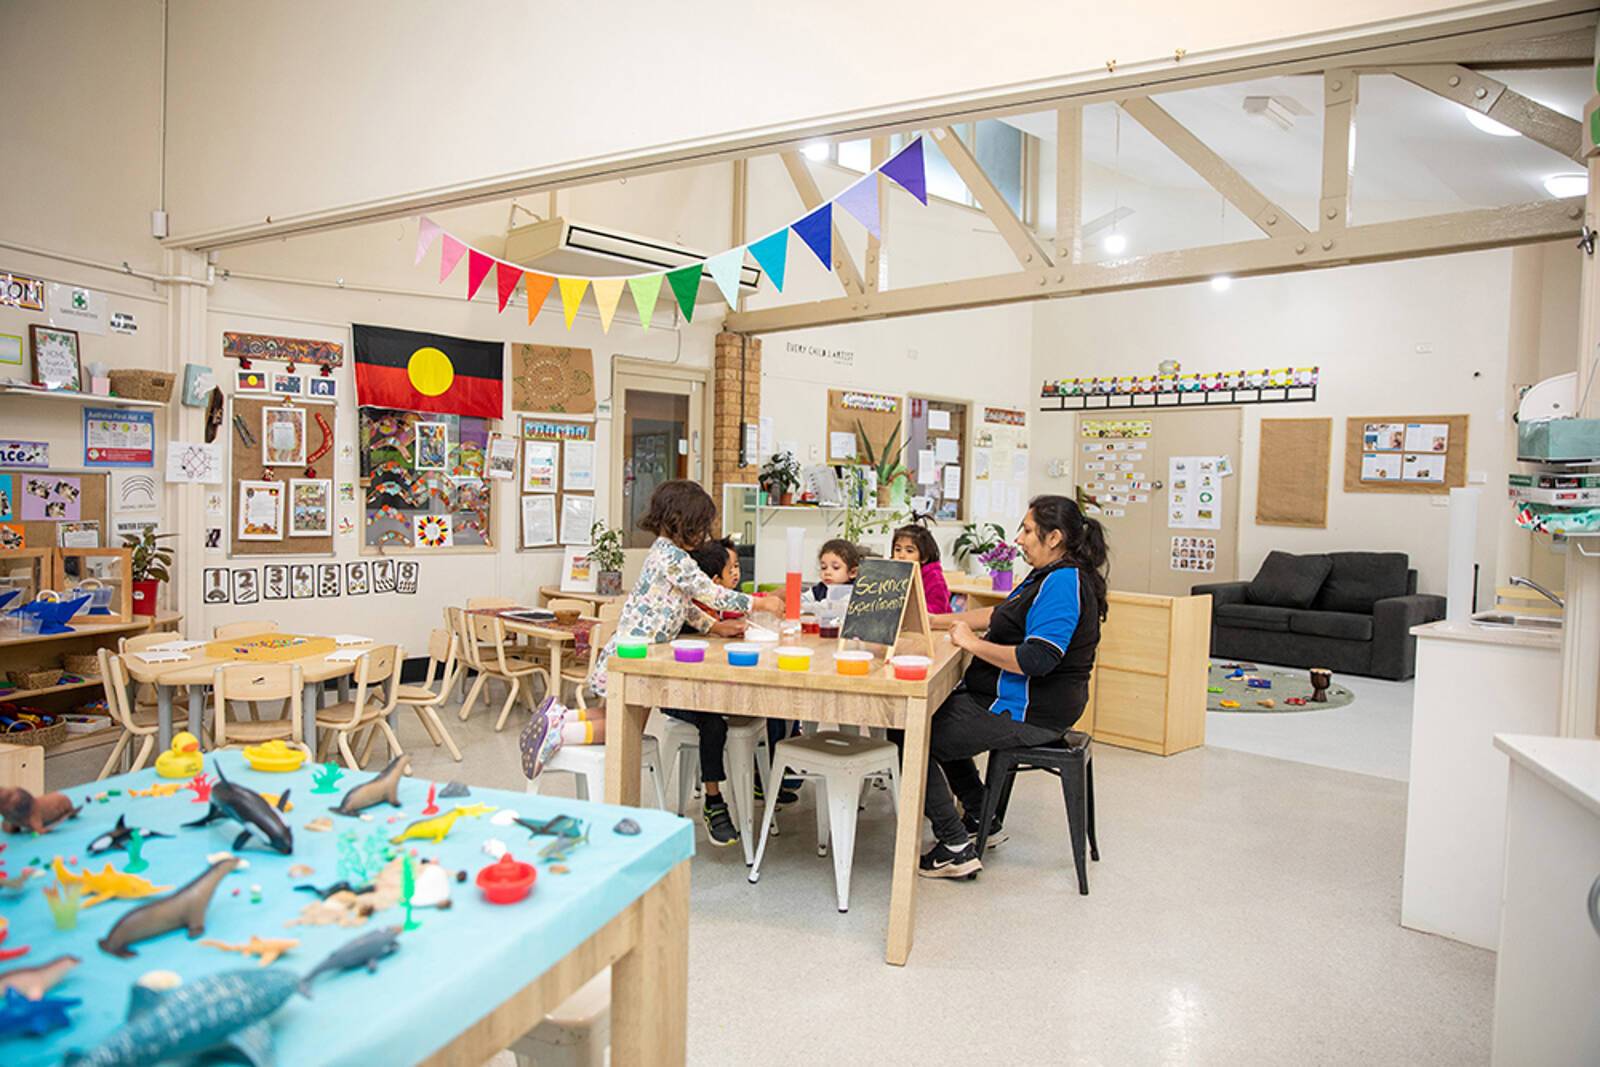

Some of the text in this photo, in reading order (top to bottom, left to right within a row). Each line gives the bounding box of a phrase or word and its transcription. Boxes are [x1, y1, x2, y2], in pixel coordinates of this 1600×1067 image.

[270, 568, 284, 583] 3
[294, 565, 309, 582] 4
[324, 566, 336, 582] 5
[351, 565, 364, 579] 6
[378, 562, 389, 577] 7
[401, 563, 414, 579] 8
[212, 569, 220, 587] 1
[239, 572, 253, 588] 2
